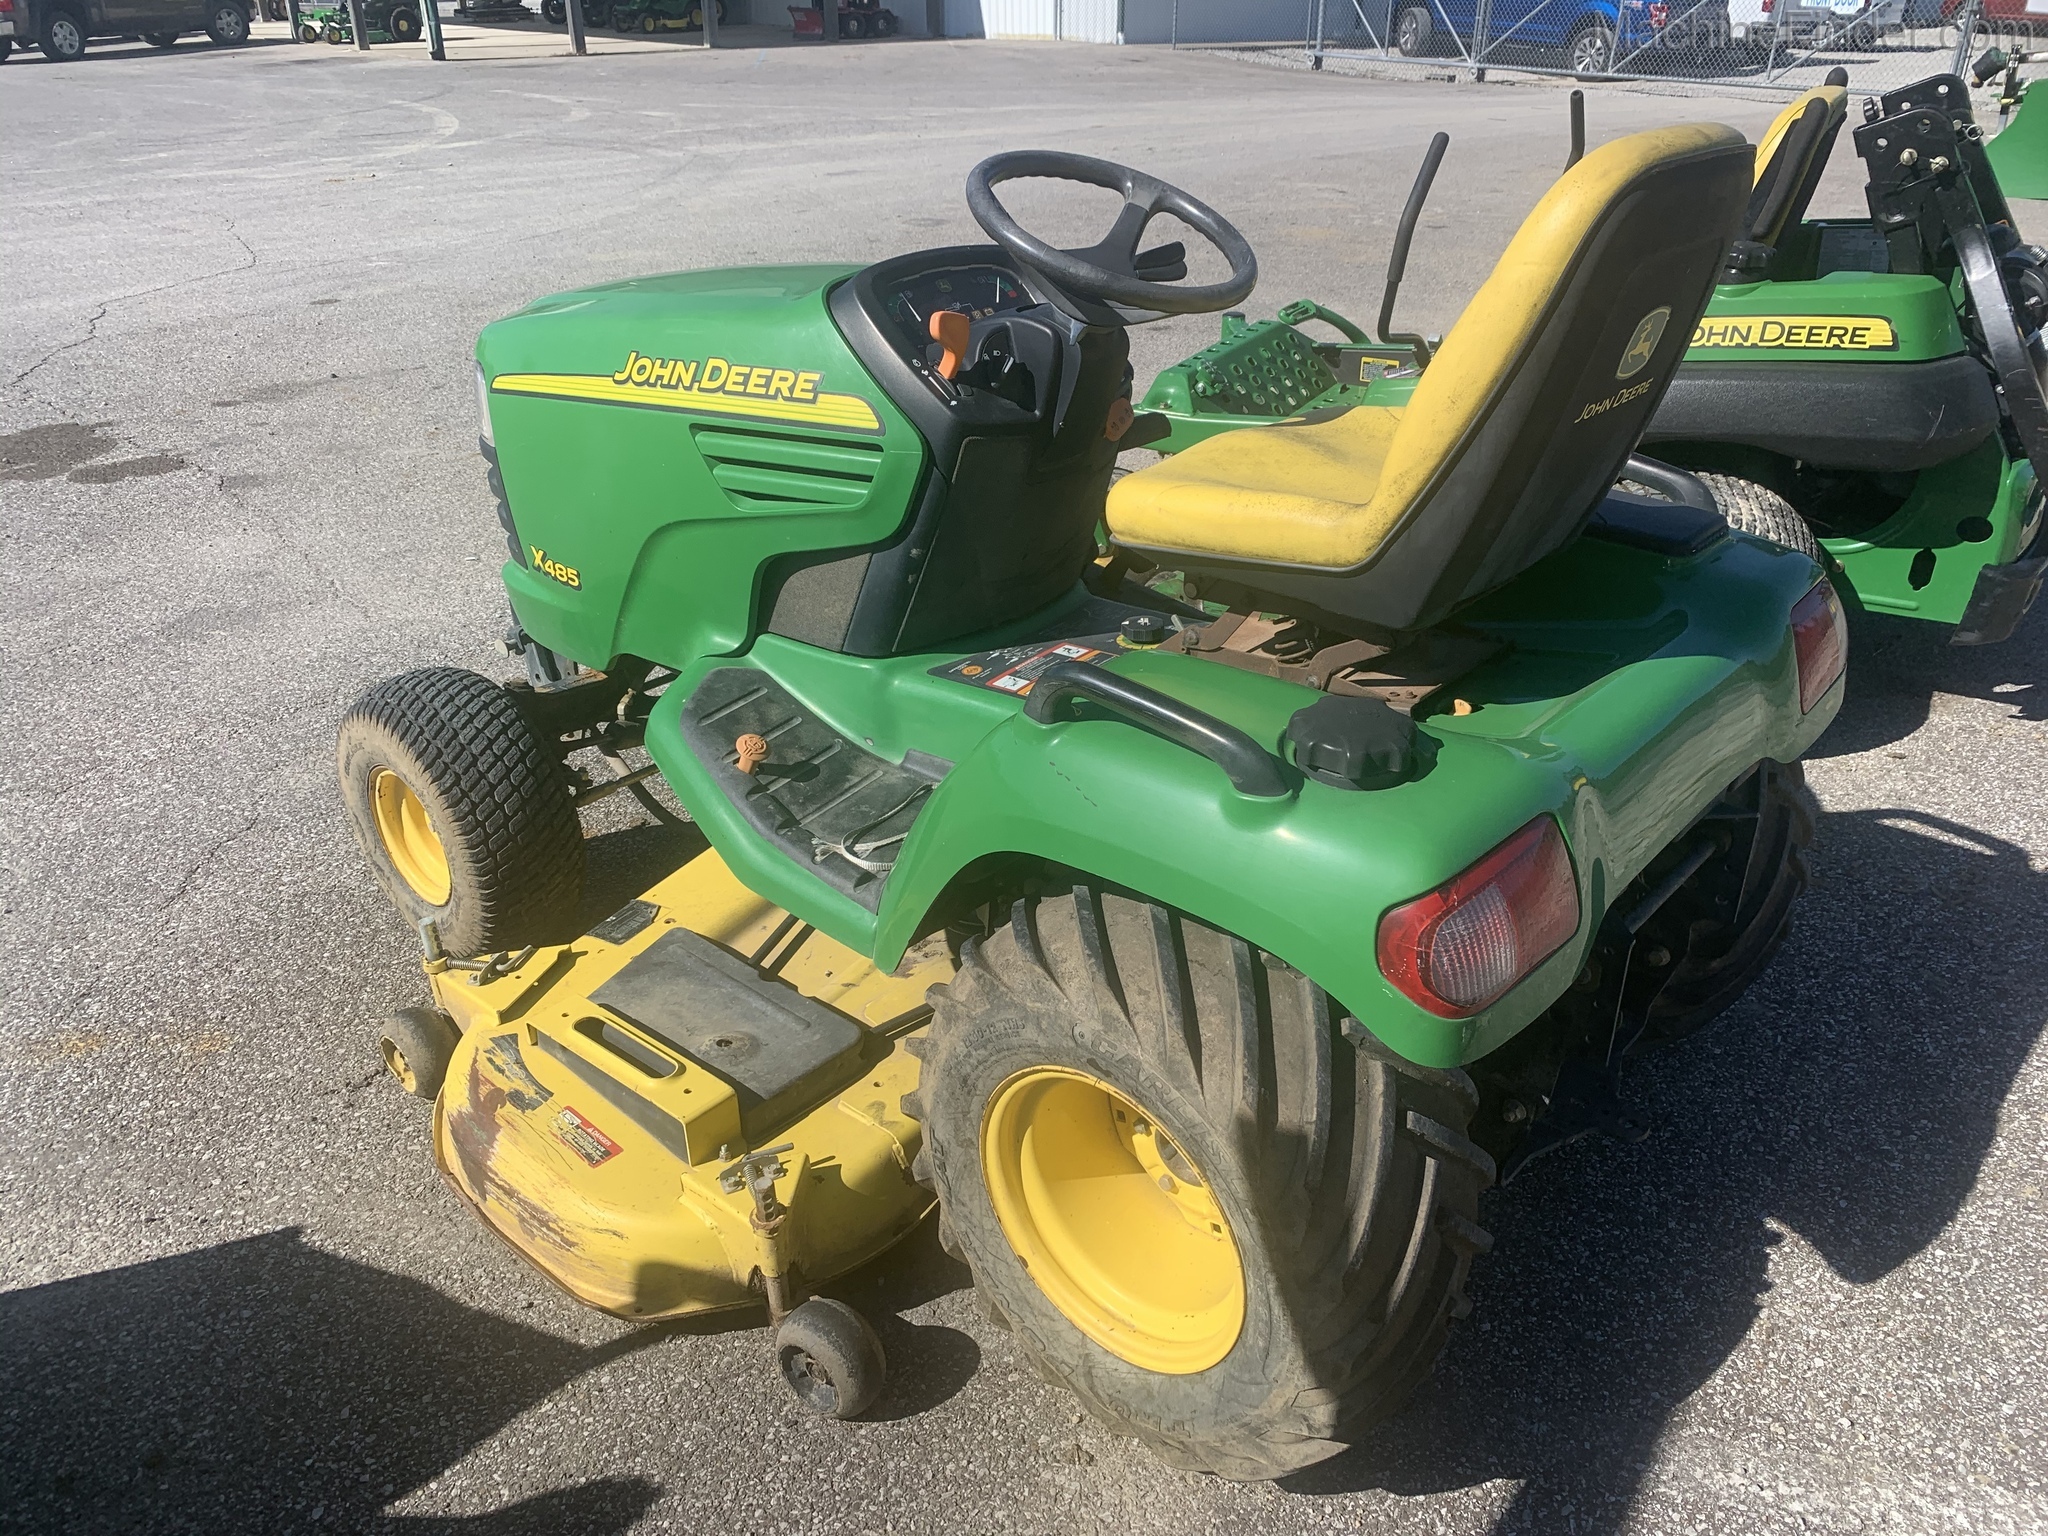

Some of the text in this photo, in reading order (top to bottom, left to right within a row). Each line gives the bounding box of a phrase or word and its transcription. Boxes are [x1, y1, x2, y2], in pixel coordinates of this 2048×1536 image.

[1691, 320, 1871, 345] OHN DEERE
[614, 351, 822, 402] JOHN DEERE
[1574, 378, 1654, 423] JOHN DEERE
[529, 544, 582, 589] X485
